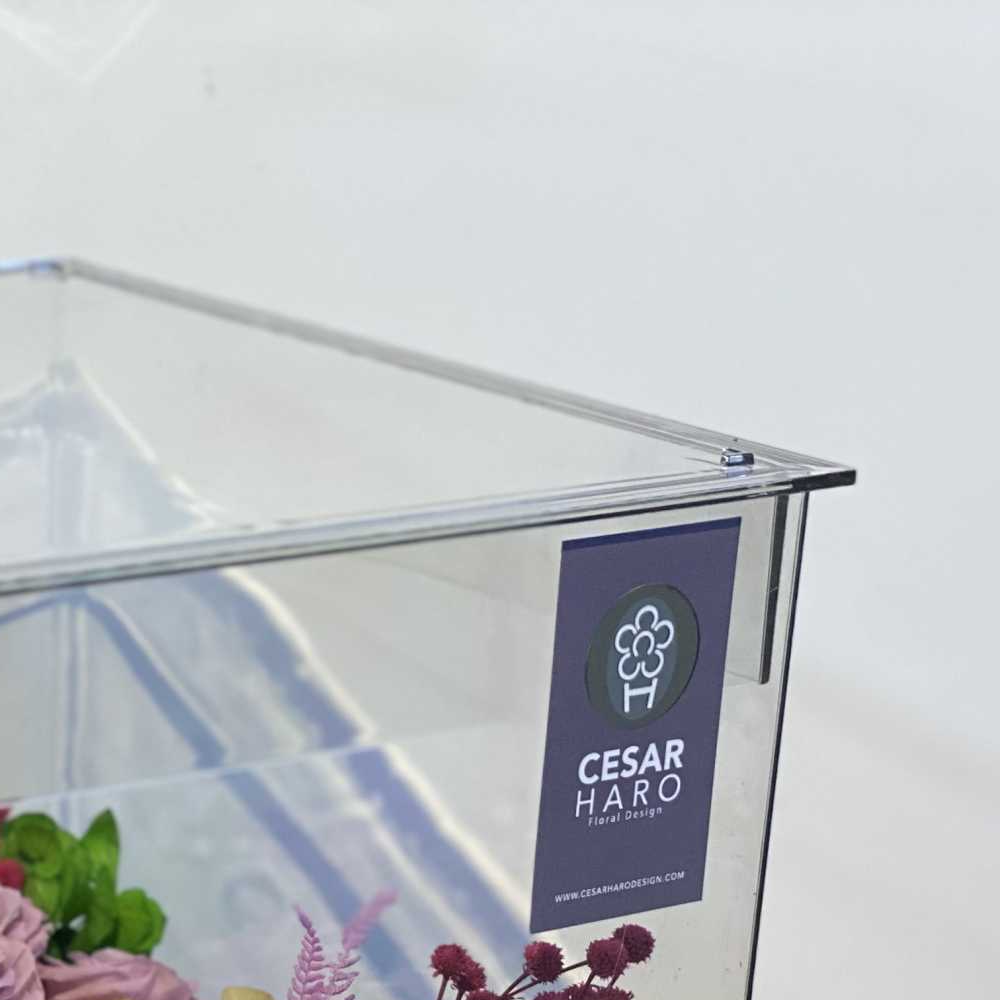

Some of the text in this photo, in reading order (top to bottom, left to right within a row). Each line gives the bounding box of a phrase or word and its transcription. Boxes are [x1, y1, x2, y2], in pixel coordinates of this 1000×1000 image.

[578, 738, 685, 785] CESAR
[575, 773, 681, 818] HARO
[588, 806, 663, 827] Floral Design
[555, 871, 685, 902] WWW.CESARHARODESIGN.COM
